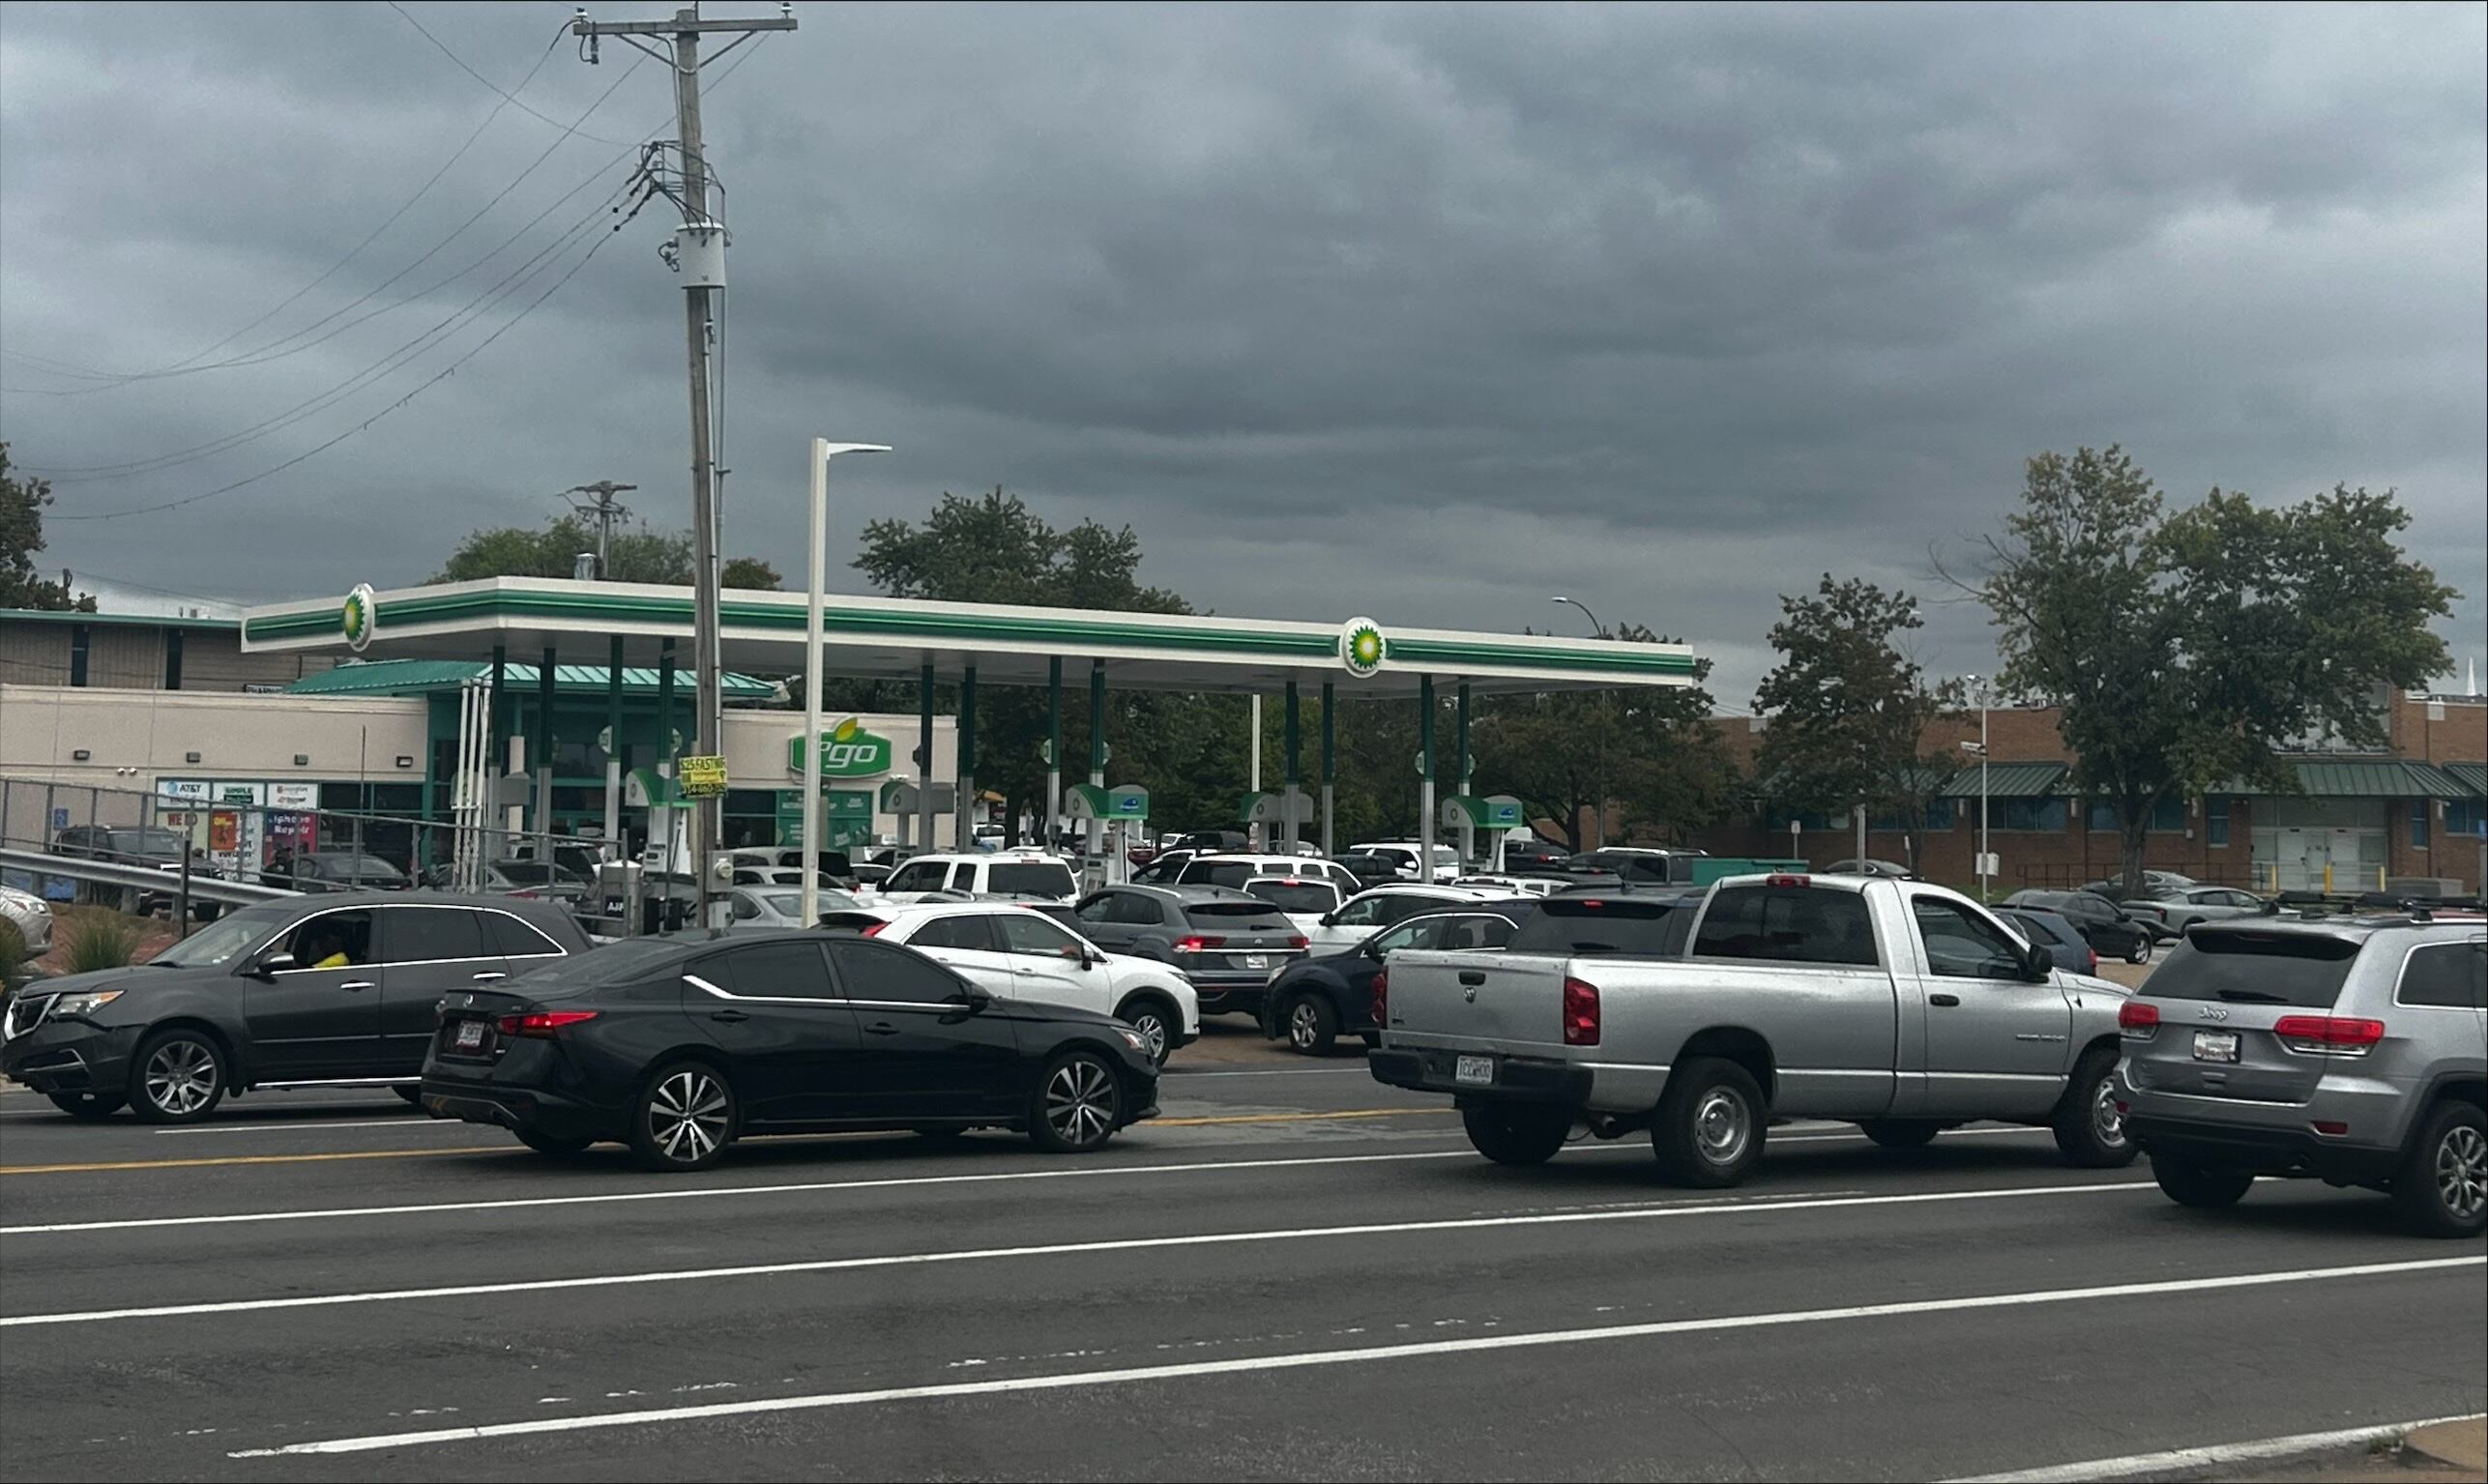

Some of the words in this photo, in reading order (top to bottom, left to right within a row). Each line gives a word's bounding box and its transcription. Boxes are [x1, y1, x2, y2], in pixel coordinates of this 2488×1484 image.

[179, 784, 201, 793] AT&T
[274, 825, 310, 835] Repir
[2198, 1005, 2228, 1022] Jeep
